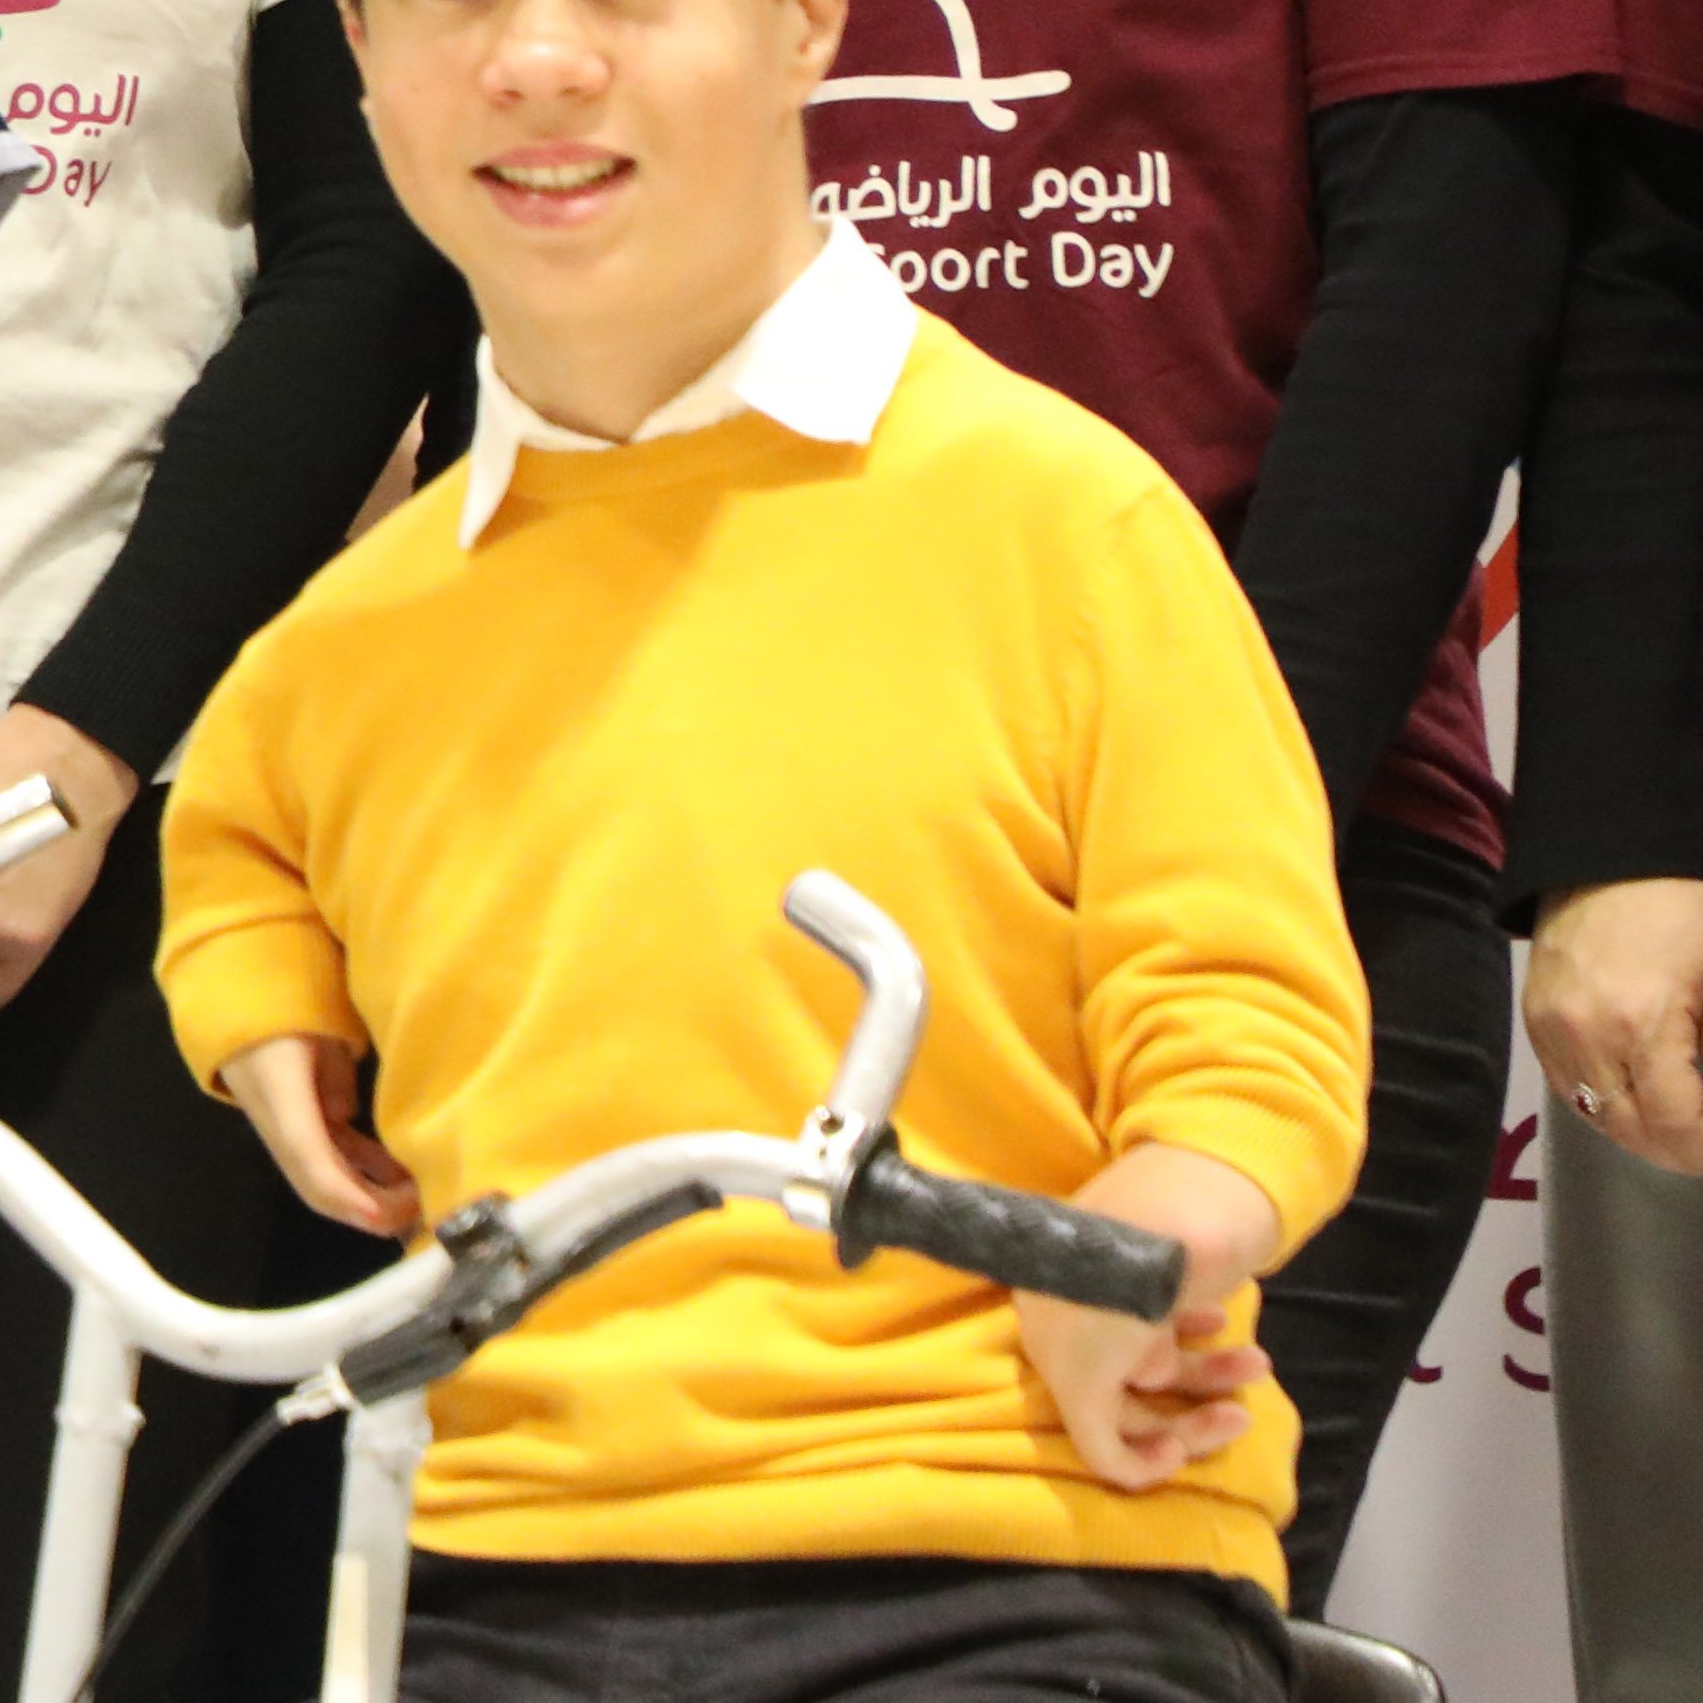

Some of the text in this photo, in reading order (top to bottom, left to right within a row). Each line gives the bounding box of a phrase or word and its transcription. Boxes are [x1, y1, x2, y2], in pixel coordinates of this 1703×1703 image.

[5, 74, 139, 137] اليوم
[1019, 151, 1172, 223] اليوم
[867, 231, 1174, 297] port Day
